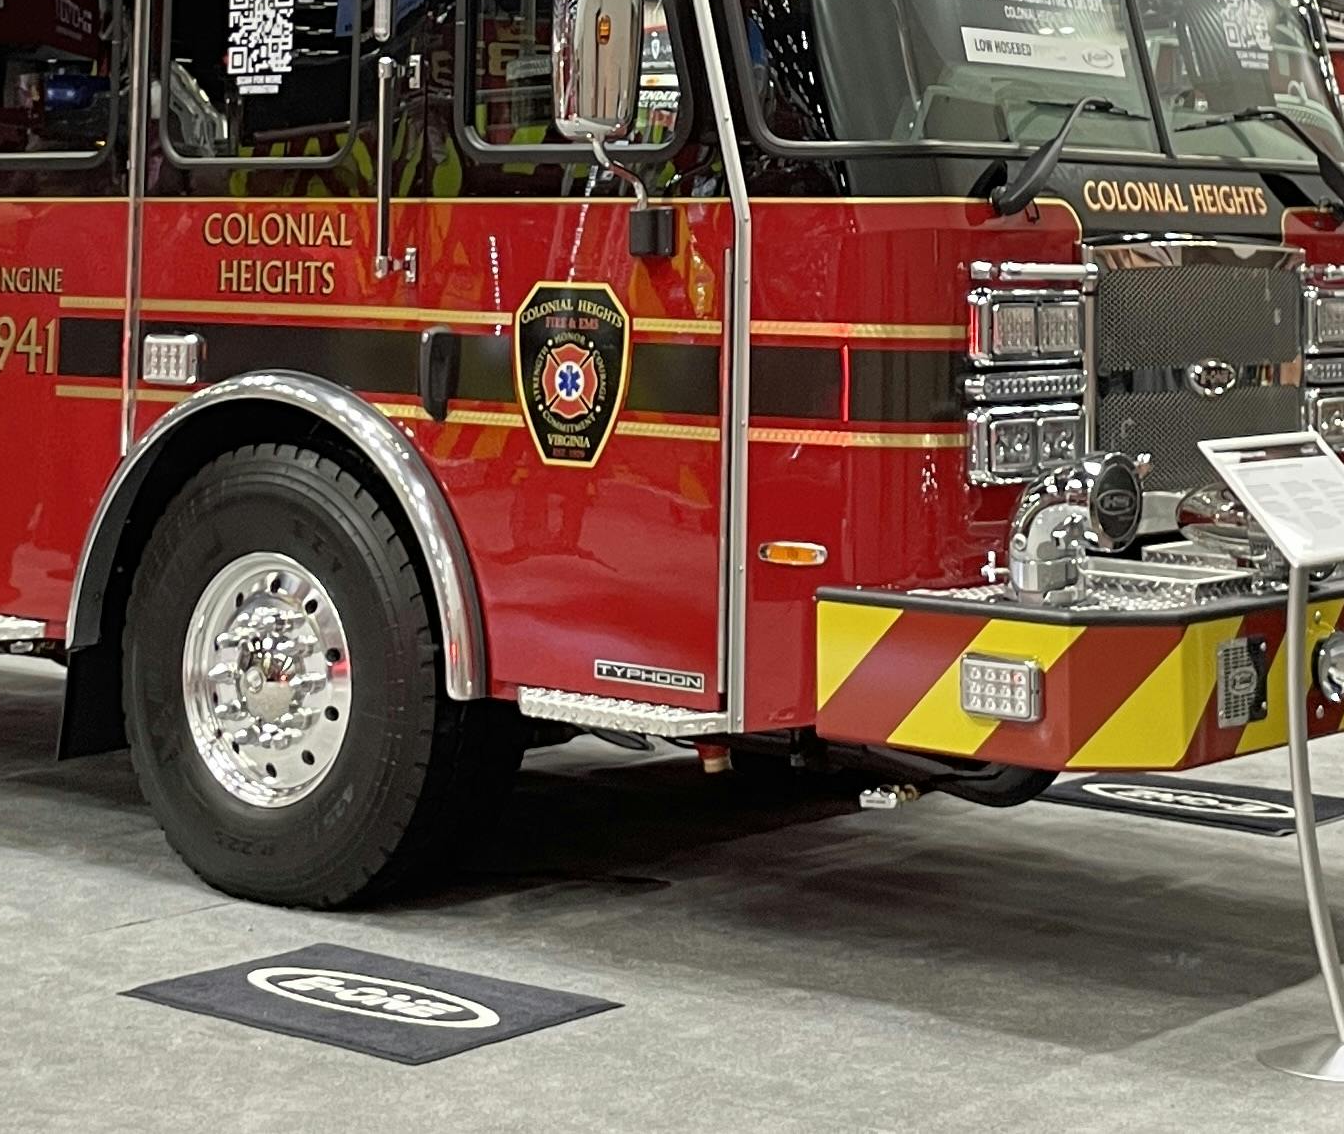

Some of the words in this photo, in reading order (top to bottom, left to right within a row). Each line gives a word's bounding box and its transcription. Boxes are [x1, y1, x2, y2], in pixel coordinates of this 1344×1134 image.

[974, 39, 993, 53] LOW
[995, 40, 1032, 57] HOSEBED
[1083, 179, 1189, 213] COLONIAL
[1189, 184, 1268, 216] HEIGHTS
[203, 212, 353, 248] COLONIAL
[219, 258, 336, 295] HEIGHTS
[521, 298, 573, 324] COLONIAL
[578, 299, 624, 329] HEIGHTS
[547, 433, 591, 449] VIRGINIA
[597, 664, 703, 688] TYPHOON
